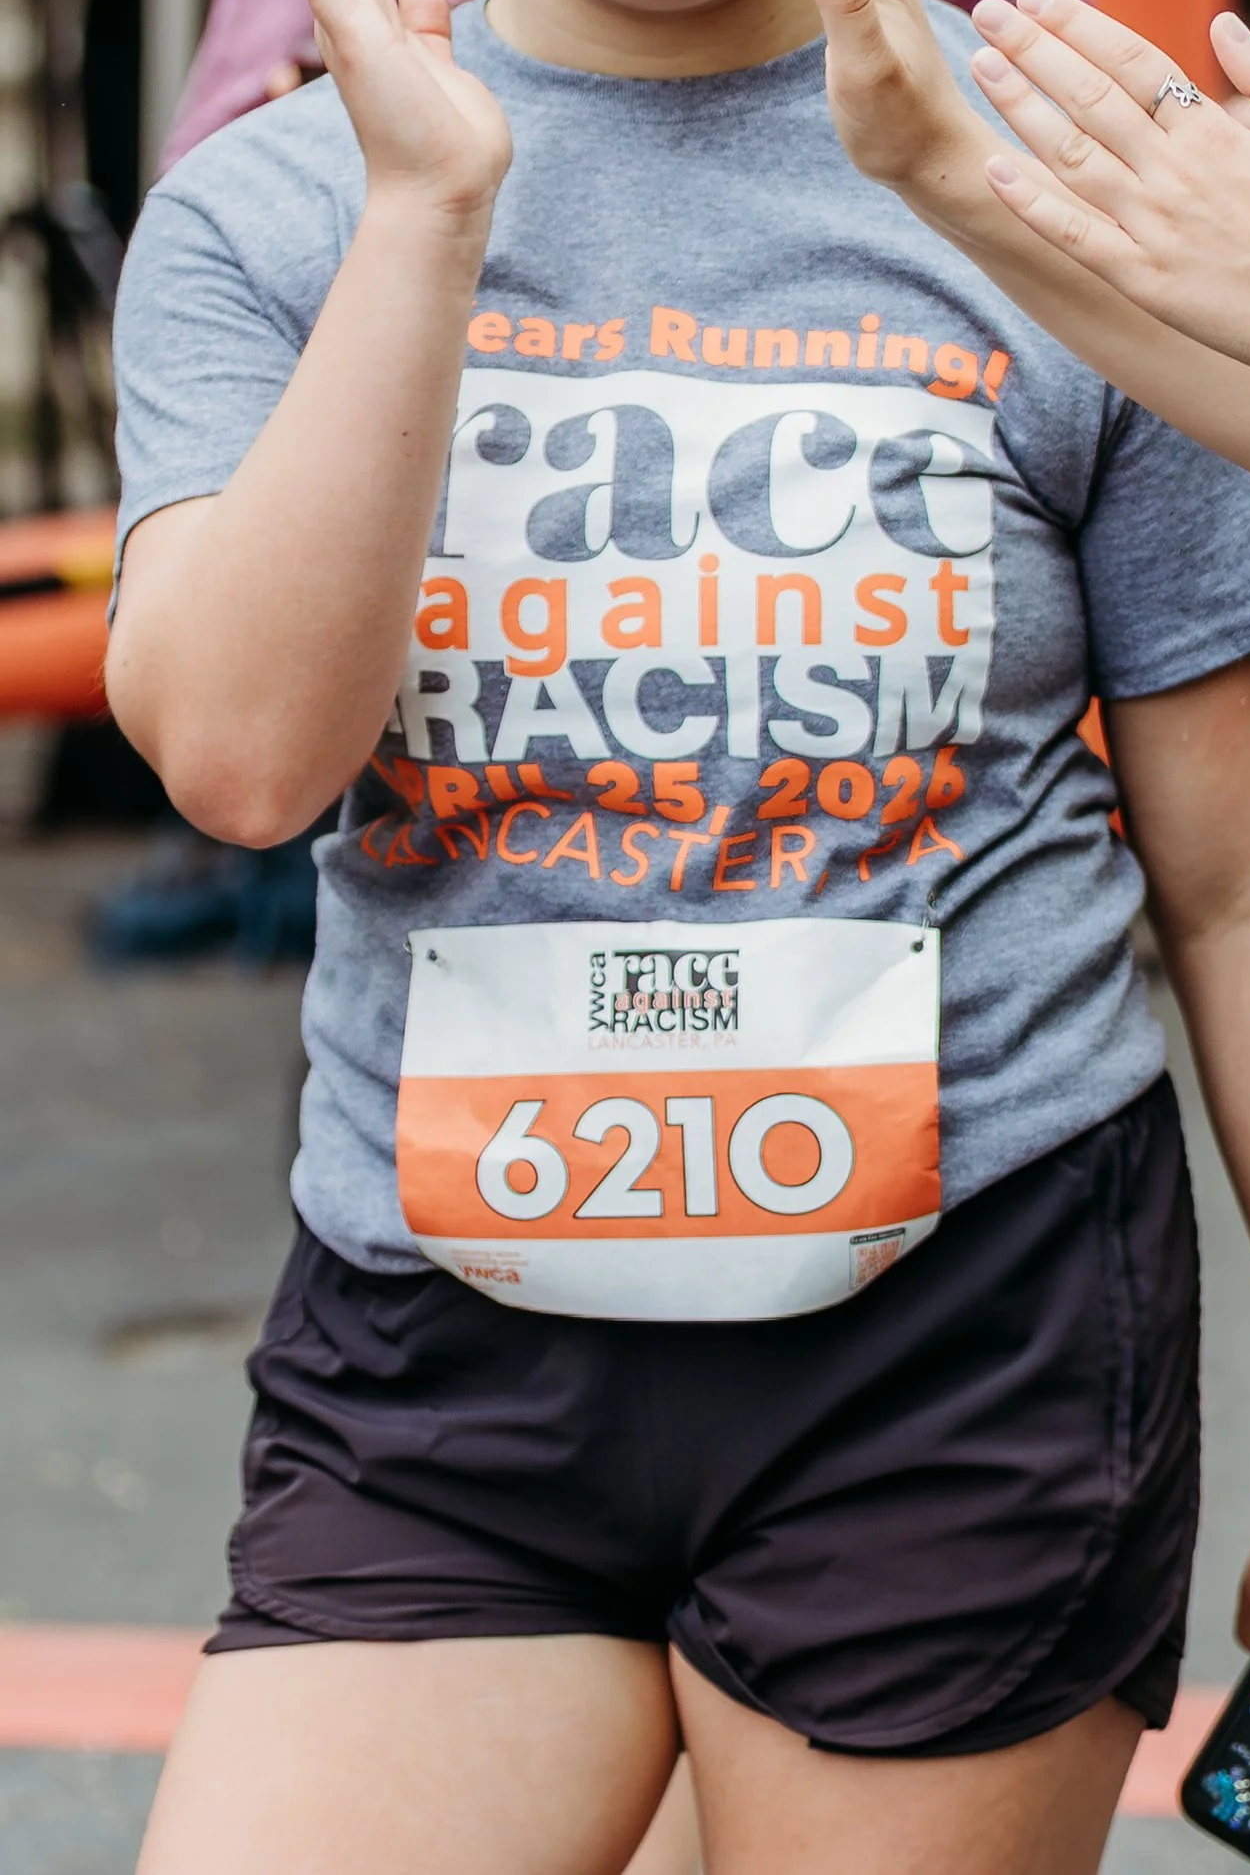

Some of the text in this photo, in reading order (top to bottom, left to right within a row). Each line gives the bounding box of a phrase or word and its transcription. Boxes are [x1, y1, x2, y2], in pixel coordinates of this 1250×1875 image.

[467, 306, 1012, 400] ears Running!
[431, 403, 995, 563] race
[413, 553, 970, 678] against
[400, 655, 985, 762] RACISM
[587, 761, 729, 836] 25,
[758, 745, 966, 823] 2026
[588, 950, 608, 1032] ywca
[609, 952, 740, 993] race
[614, 986, 734, 1014] against
[587, 1032, 737, 1051] LANCASTER, PA
[610, 1008, 739, 1033] RACISM
[475, 1092, 856, 1221] 6210
